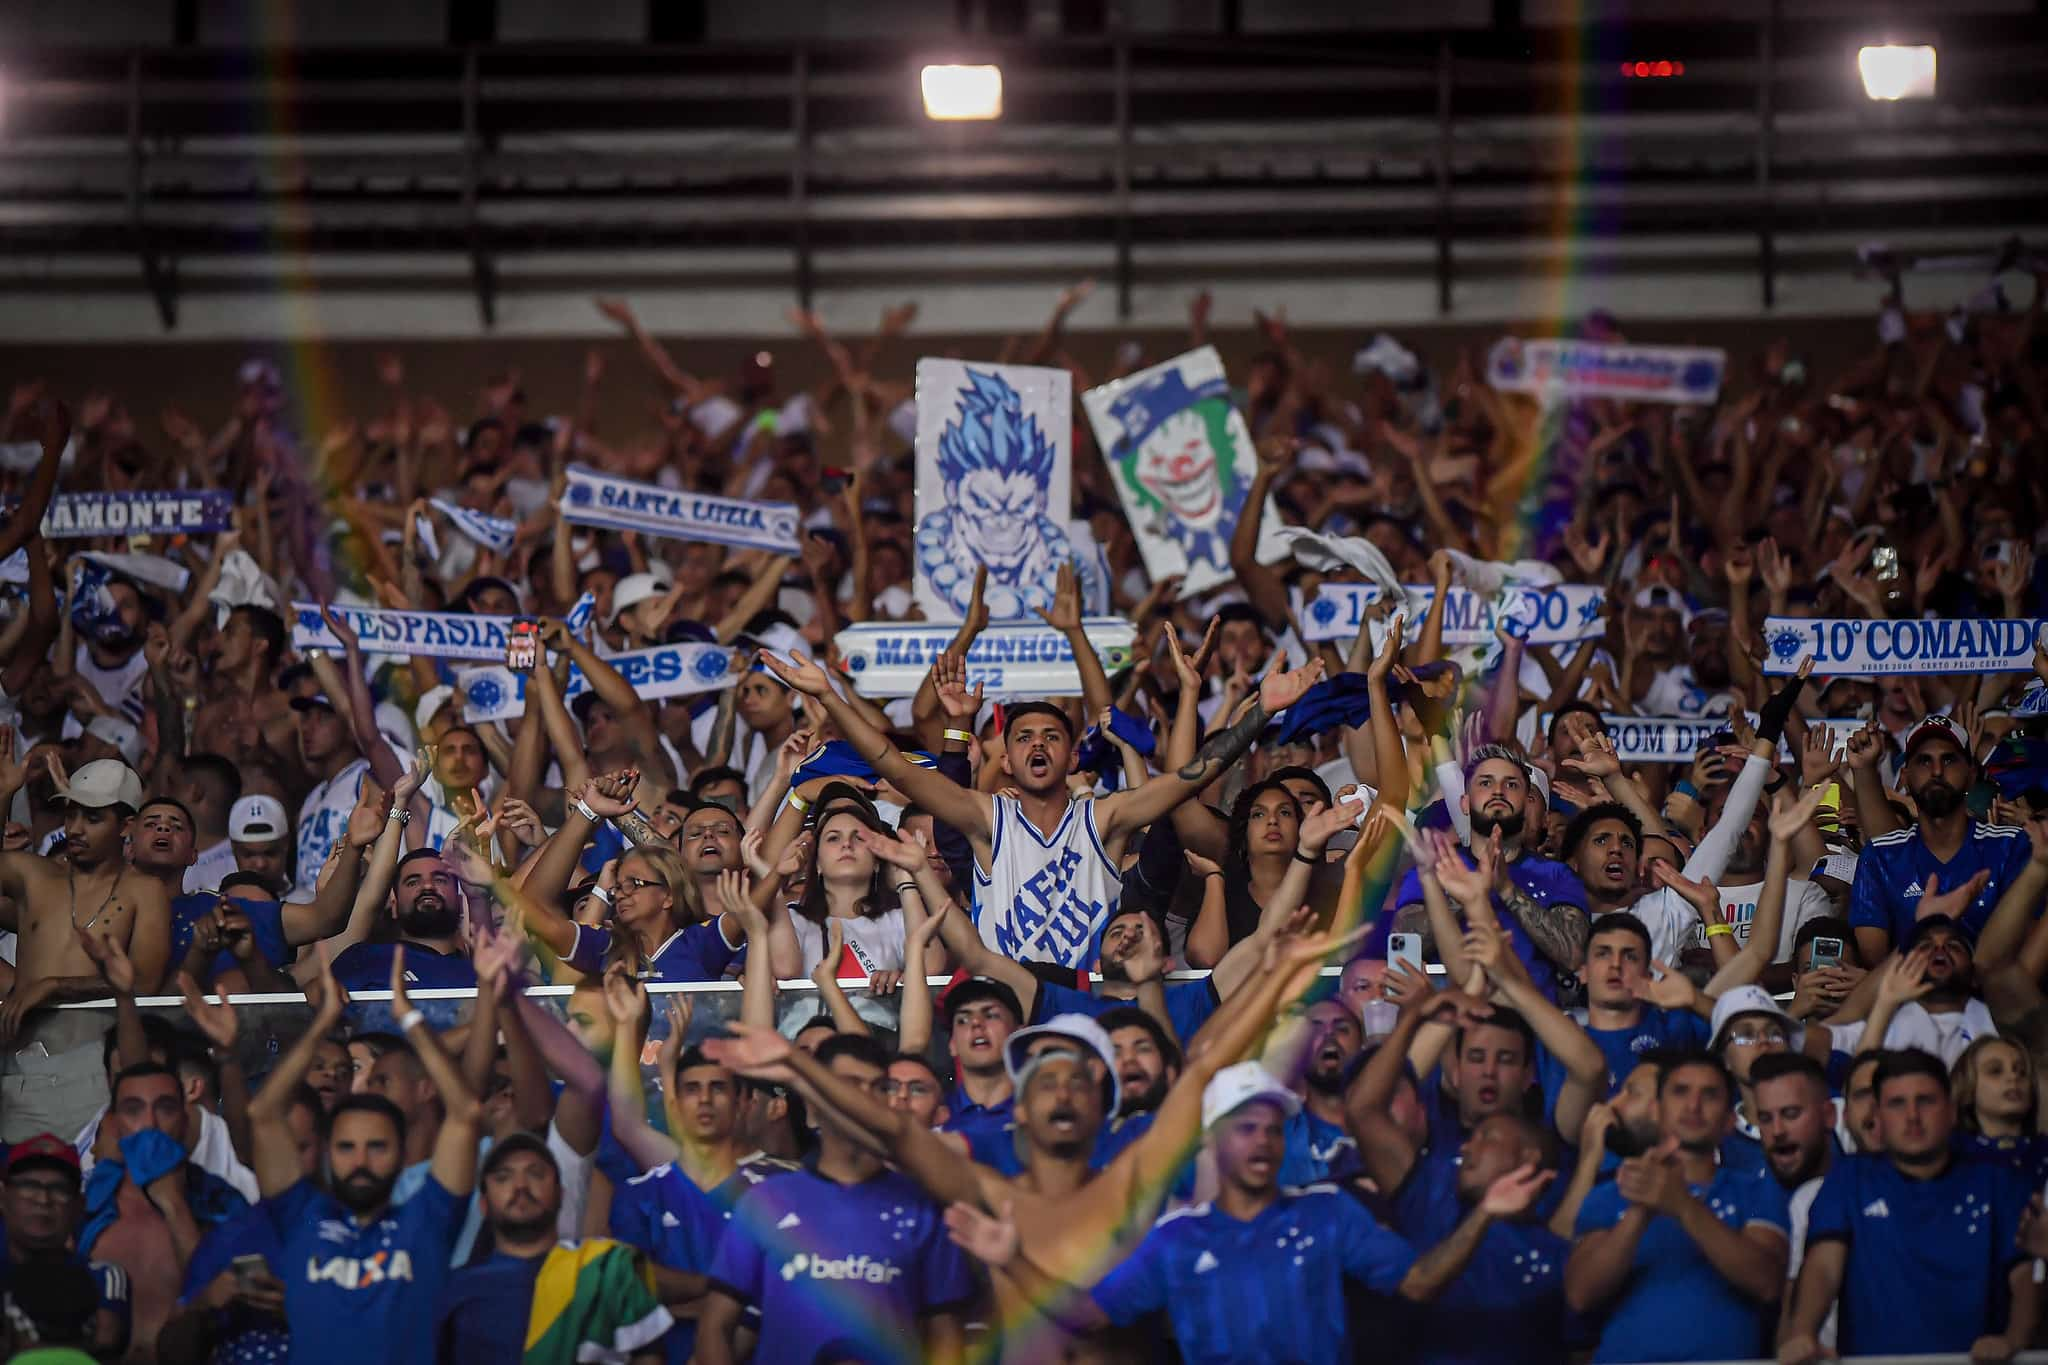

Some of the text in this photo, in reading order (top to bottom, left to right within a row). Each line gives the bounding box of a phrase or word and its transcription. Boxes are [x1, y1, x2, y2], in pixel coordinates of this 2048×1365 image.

[601, 485, 684, 517] SANTA
[692, 500, 766, 531] LUZIA
[875, 633, 1075, 666] MATZINHOS
[1605, 724, 1665, 753] BOM
[1019, 887, 1103, 966] ZUL
[850, 940, 877, 973] QUE SE
[810, 1252, 902, 1284] betfair
